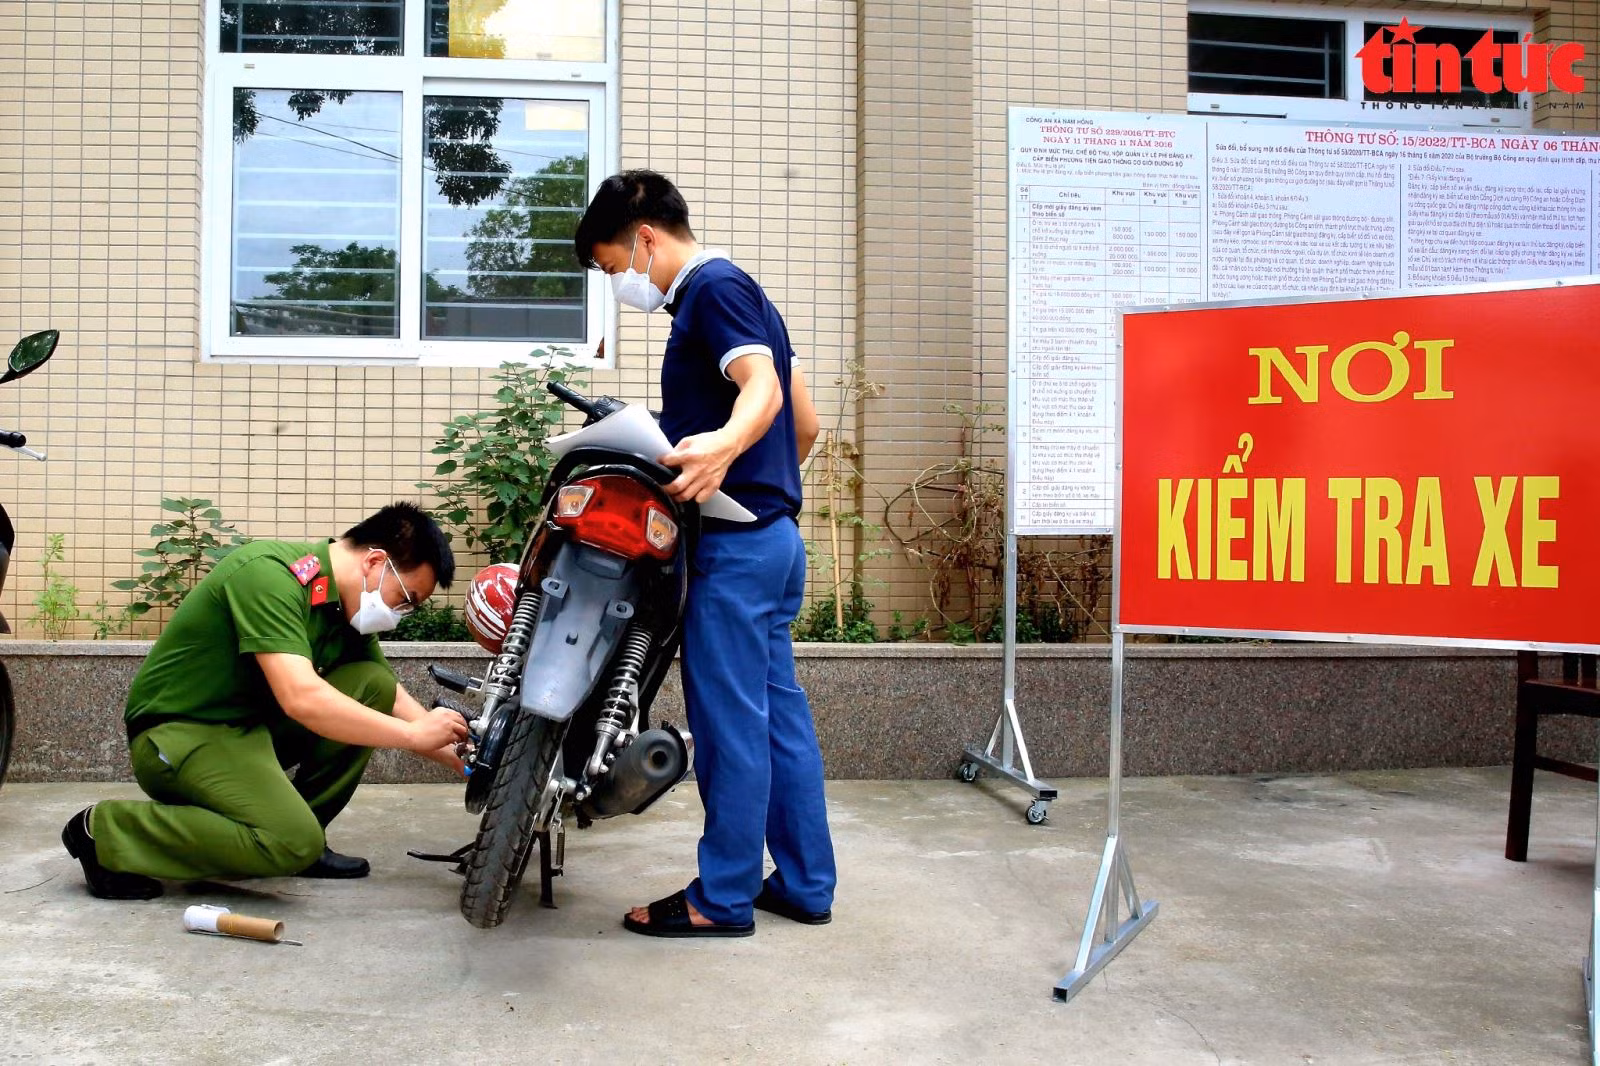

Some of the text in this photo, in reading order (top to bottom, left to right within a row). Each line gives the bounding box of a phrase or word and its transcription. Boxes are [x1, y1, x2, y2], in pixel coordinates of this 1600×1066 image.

[1040, 125, 1073, 134] THÔNG
[1076, 126, 1089, 134] TƯ
[1106, 129, 1176, 138] 229/2016/TT-BTC
[1305, 129, 1600, 152] THÔNG TƯ SỐ: 15/2022/TT-BCA NGÀY 06 THÁN
[1130, 139, 1152, 147] NĂM
[1248, 144, 1261, 152] sung
[1308, 147, 1324, 155] Thông
[1502, 154, 1516, 162] Công
[1248, 331, 1454, 404] NƠI
[1158, 433, 1560, 588] KIỂM TRA XE
